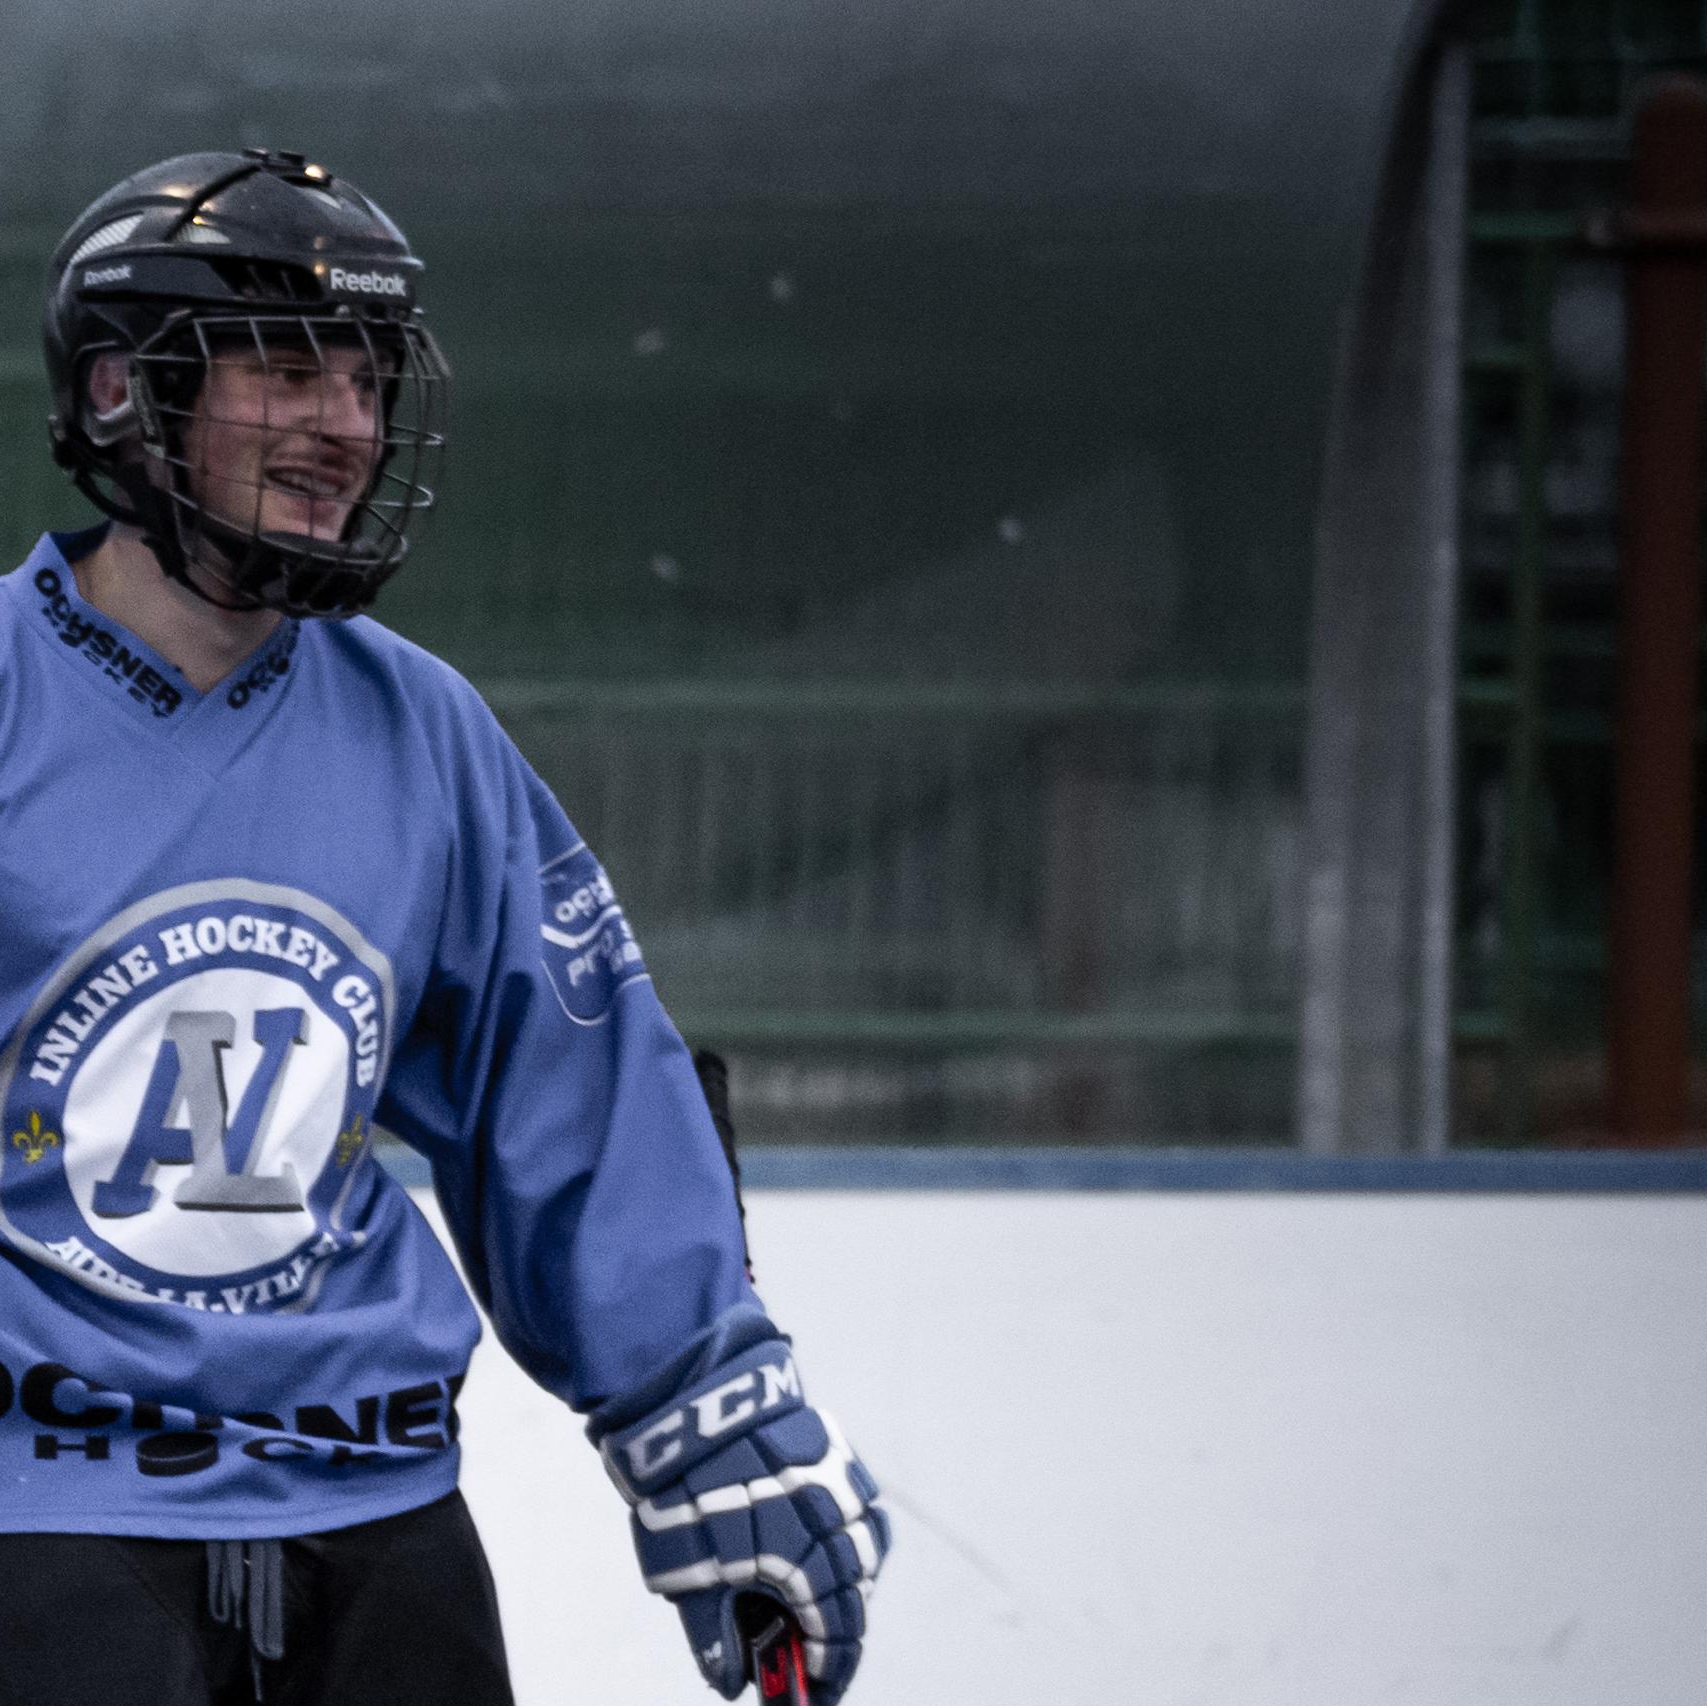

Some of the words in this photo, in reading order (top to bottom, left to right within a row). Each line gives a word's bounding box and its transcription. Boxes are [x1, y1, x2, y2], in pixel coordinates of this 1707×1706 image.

[329, 267, 407, 297] Reebok
[29, 944, 160, 1087] INLINE
[157, 914, 339, 982] HOCKEY
[331, 975, 380, 1088] CLUB
[626, 1355, 802, 1481] CCM
